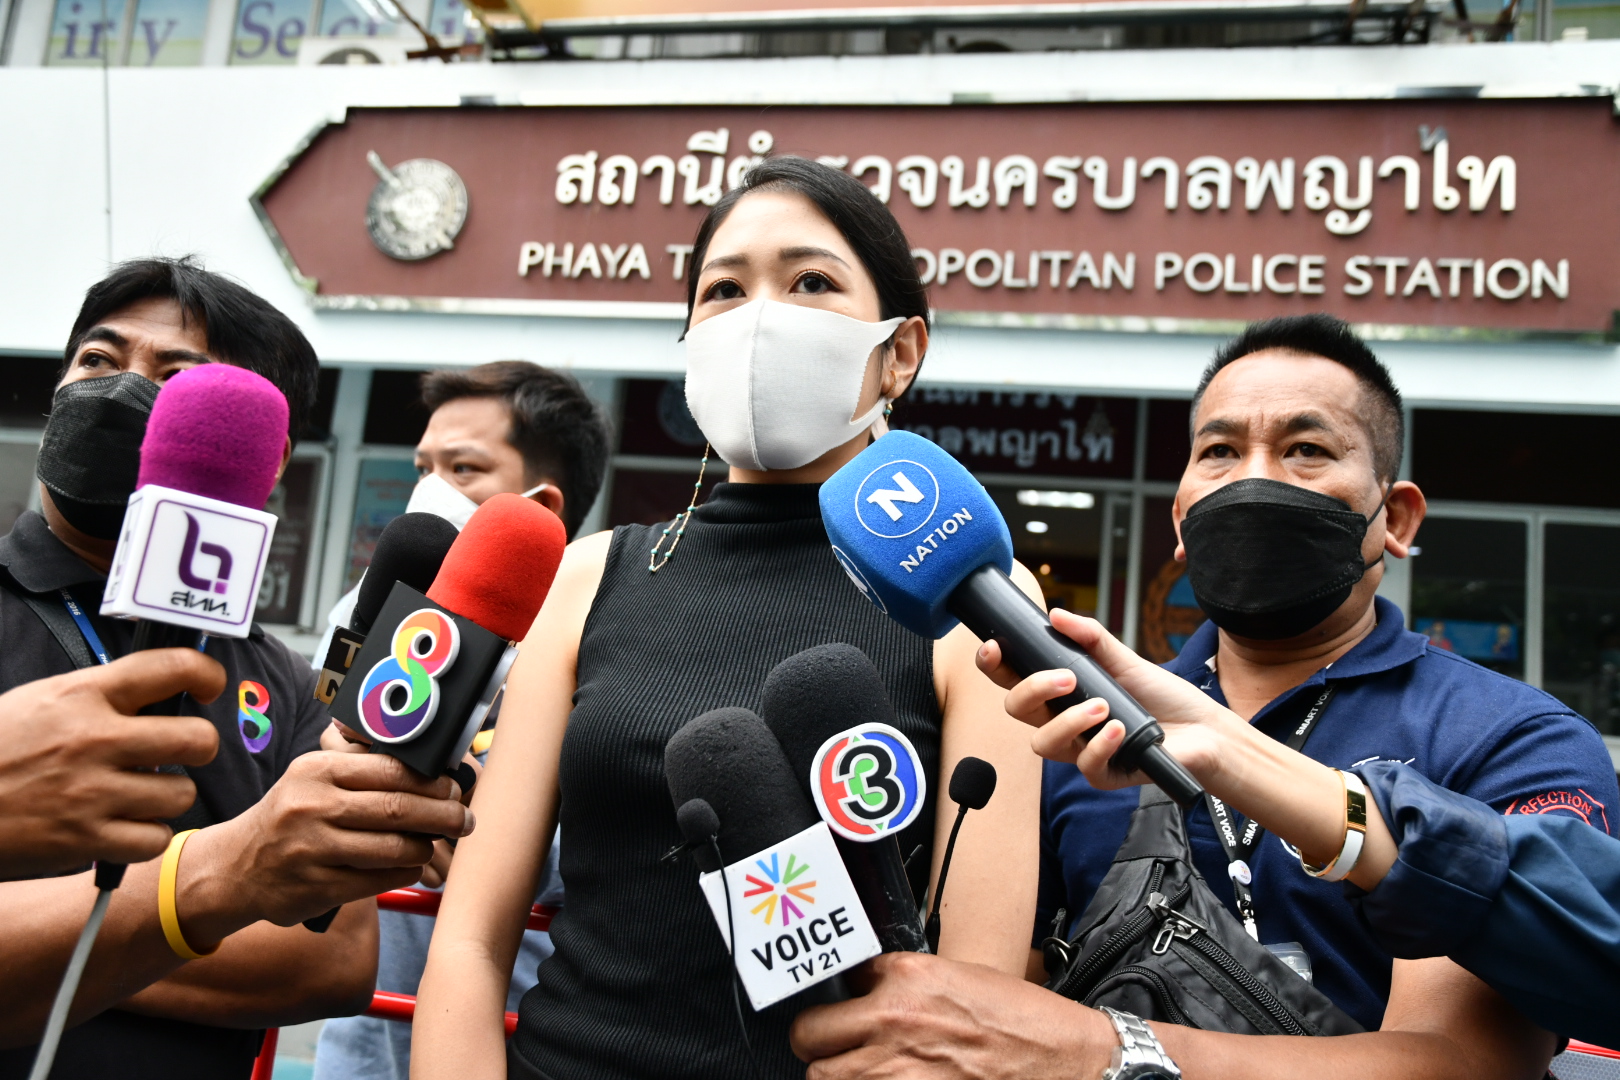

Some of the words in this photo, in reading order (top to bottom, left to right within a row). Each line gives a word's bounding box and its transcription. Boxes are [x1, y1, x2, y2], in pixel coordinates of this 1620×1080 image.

[555, 125, 1518, 236] สถานีวจนครบาลพญาไท
[518, 242, 651, 280] PHAYA
[911, 248, 1136, 290] OPOLITAN
[1155, 252, 1326, 294] POLICE
[1343, 256, 1570, 299] STATION
[866, 471, 925, 522] N
[899, 507, 973, 573] NATION
[1295, 706, 1319, 736] SMART
[1210, 794, 1227, 818] ART
[1219, 818, 1237, 847] VOICE
[1520, 791, 1593, 815] RFECTION
[1242, 819, 1259, 846] SMA
[750, 906, 855, 971] VOICE
[786, 958, 814, 983] TV
[818, 947, 842, 971] 21
